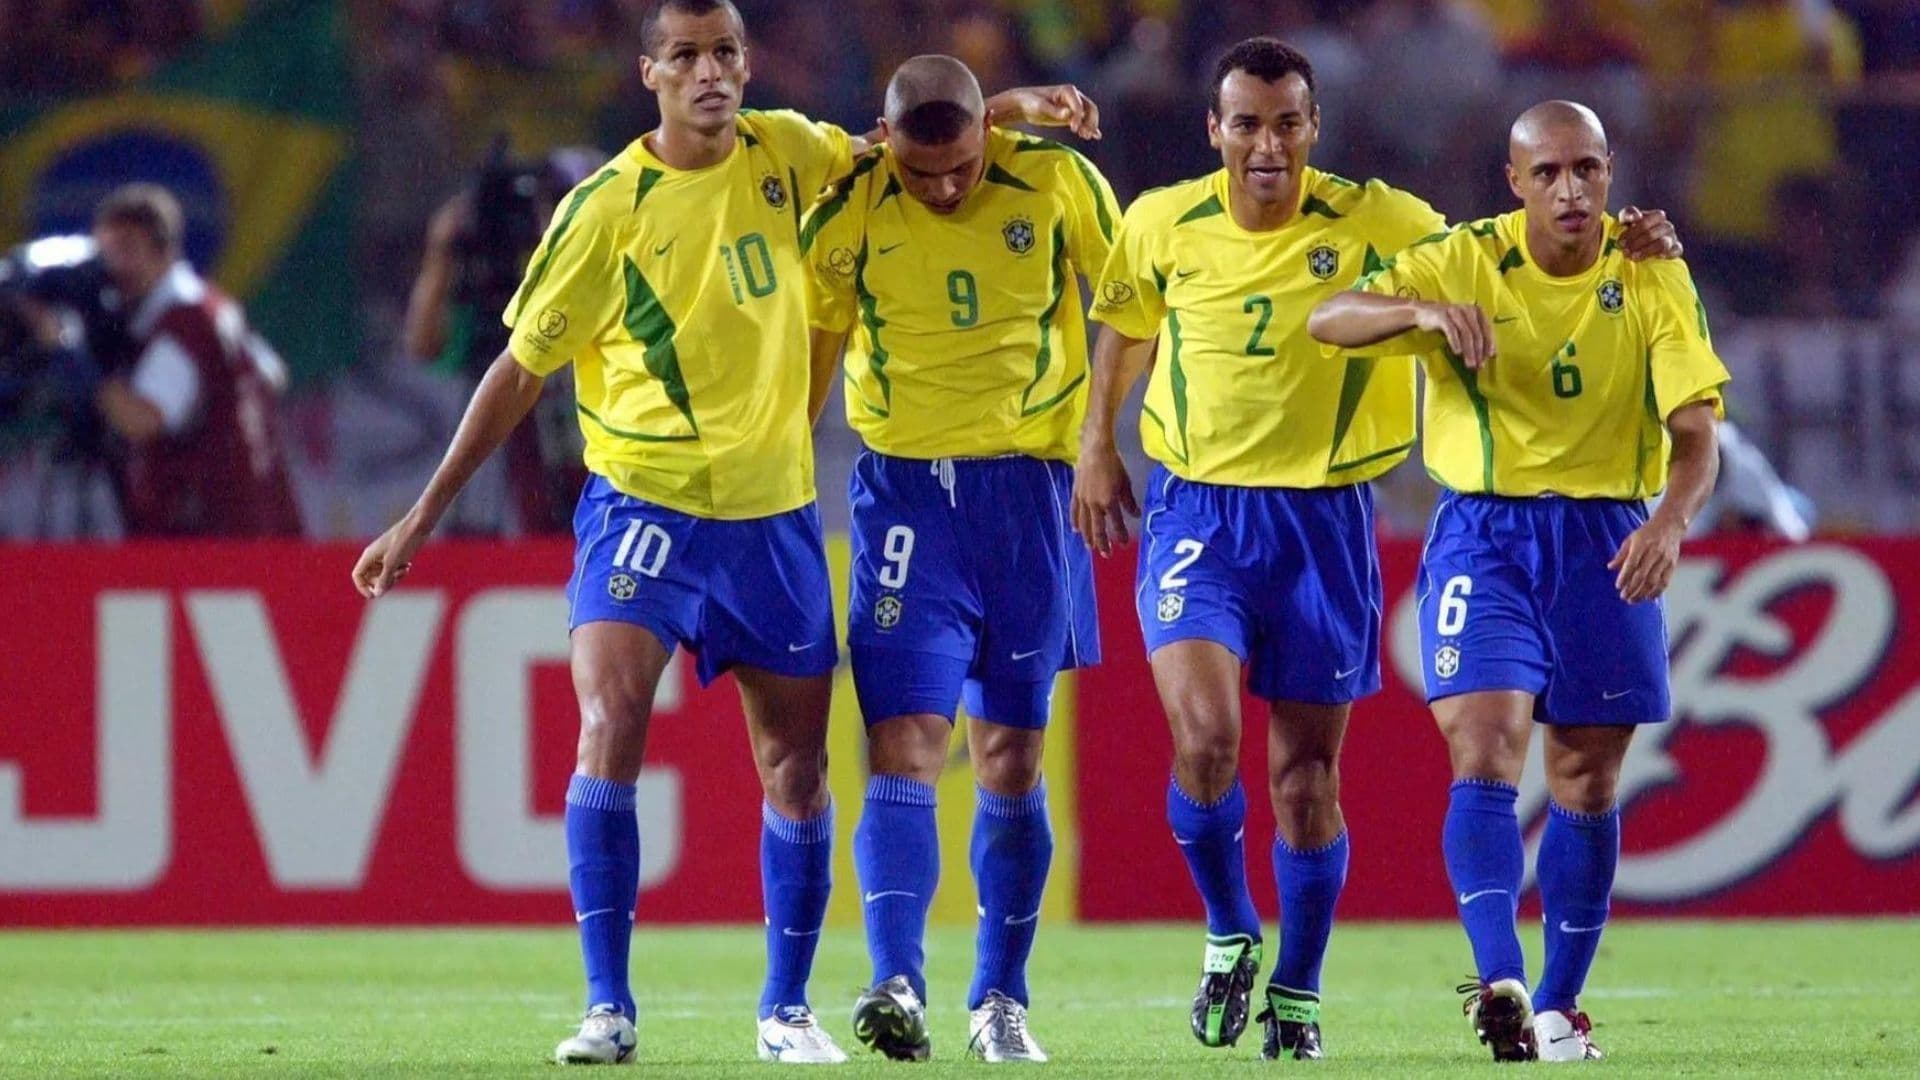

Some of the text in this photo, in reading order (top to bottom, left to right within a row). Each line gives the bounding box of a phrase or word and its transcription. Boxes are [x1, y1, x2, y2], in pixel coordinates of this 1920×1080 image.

[719, 232, 777, 305] 10
[947, 269, 978, 327] 9
[1243, 295, 1275, 356] 2
[1552, 340, 1582, 398] 6
[612, 518, 671, 578] 10
[879, 525, 915, 589] 9
[1160, 539, 1204, 590] 2
[1437, 575, 1473, 636] 6
[0, 589, 683, 893] JVC
